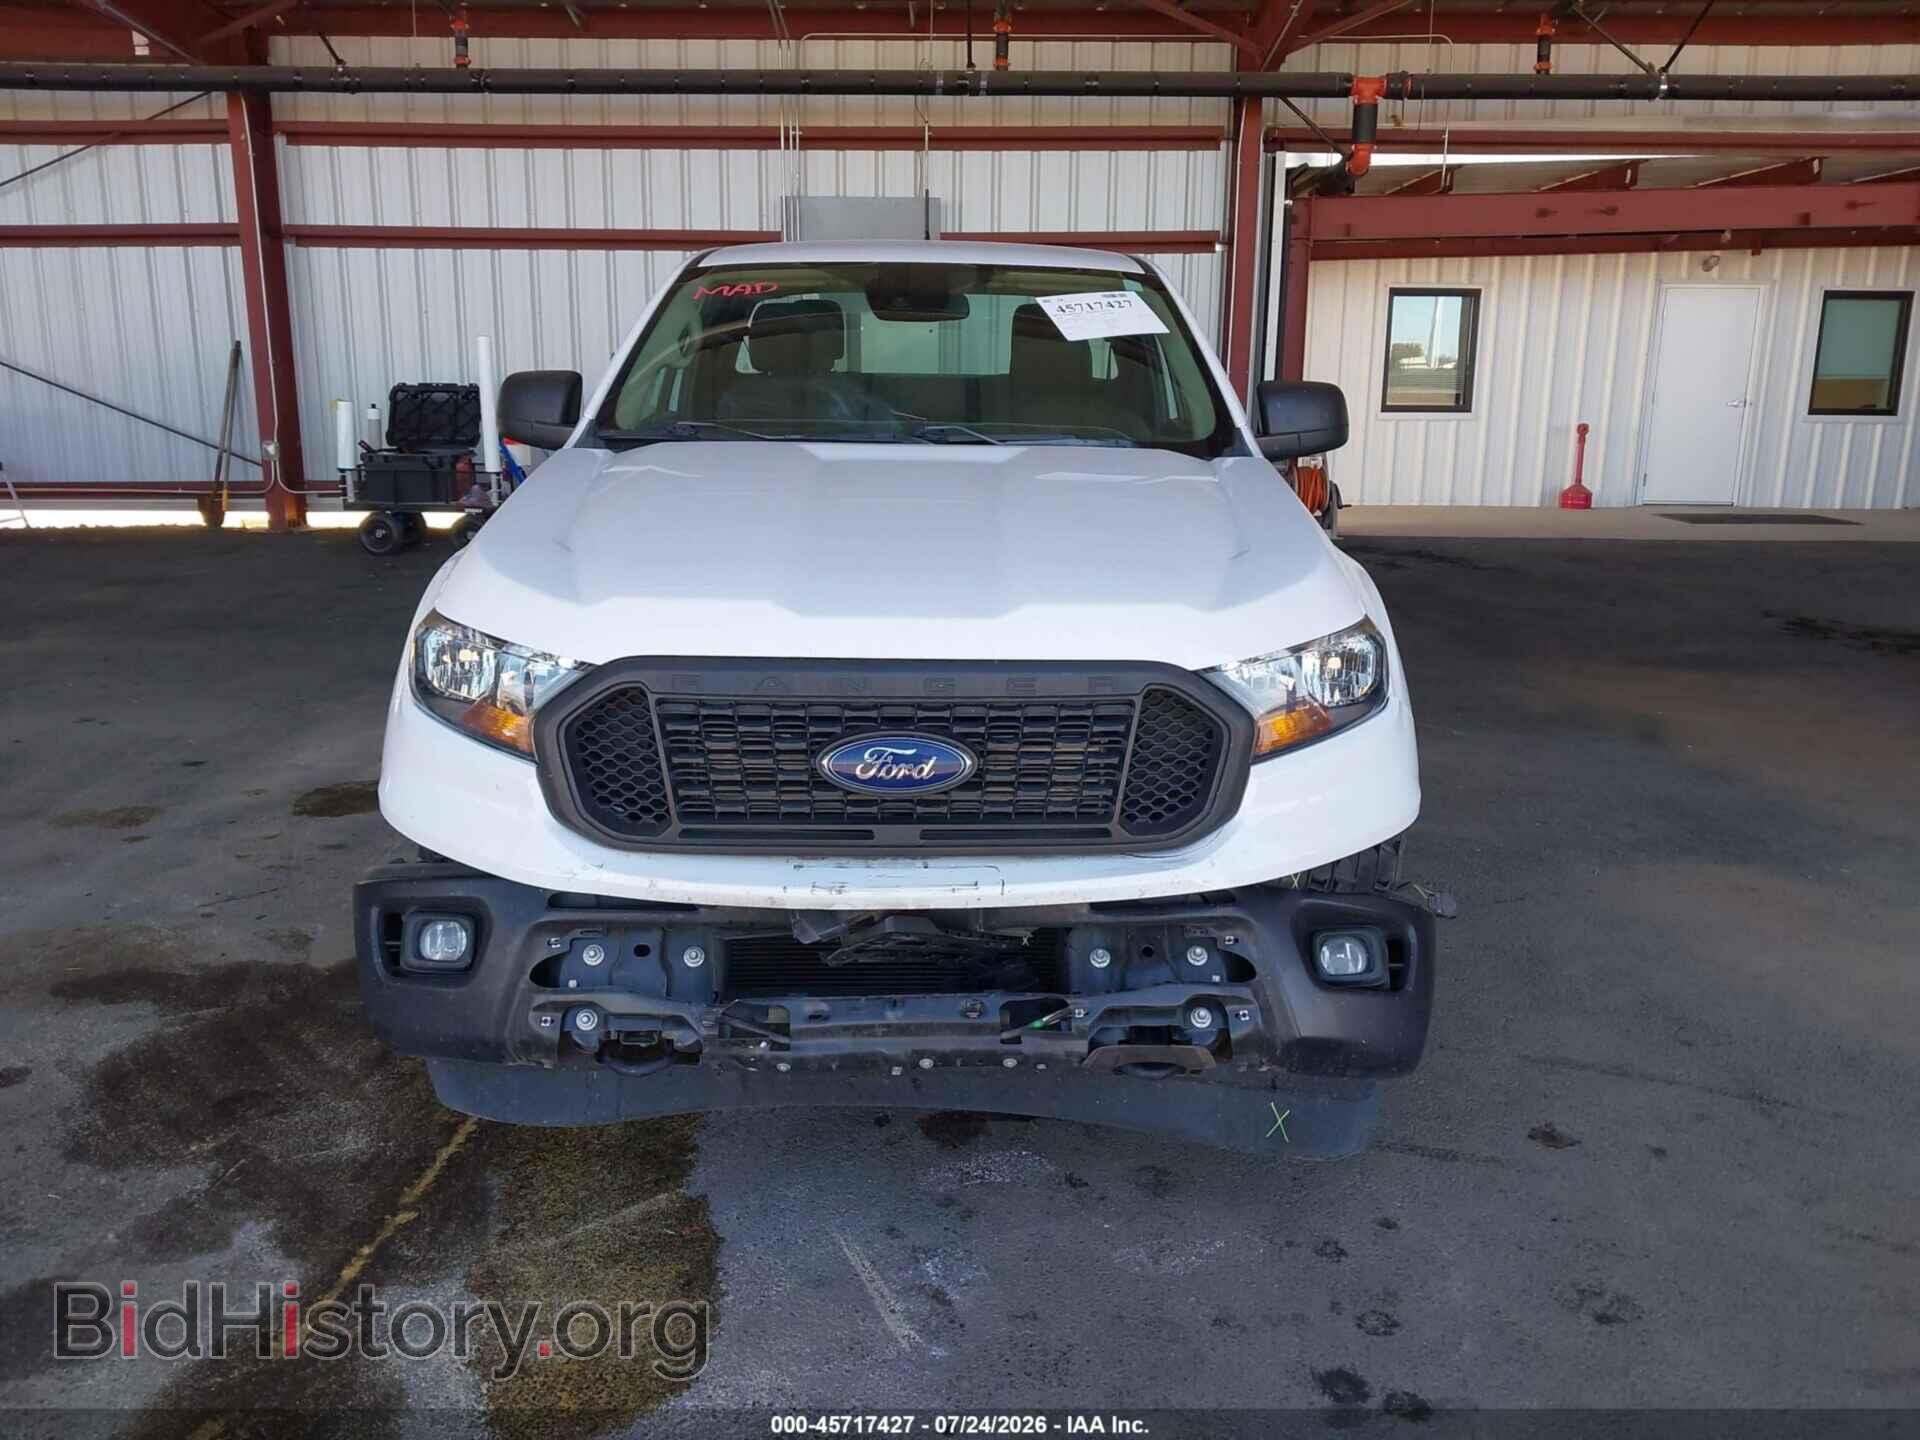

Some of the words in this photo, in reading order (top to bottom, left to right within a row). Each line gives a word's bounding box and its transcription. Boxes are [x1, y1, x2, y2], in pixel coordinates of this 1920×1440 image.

[1056, 299, 1133, 314] 45717427
[672, 673, 1118, 695] RANGER
[855, 746, 938, 781] Ford
